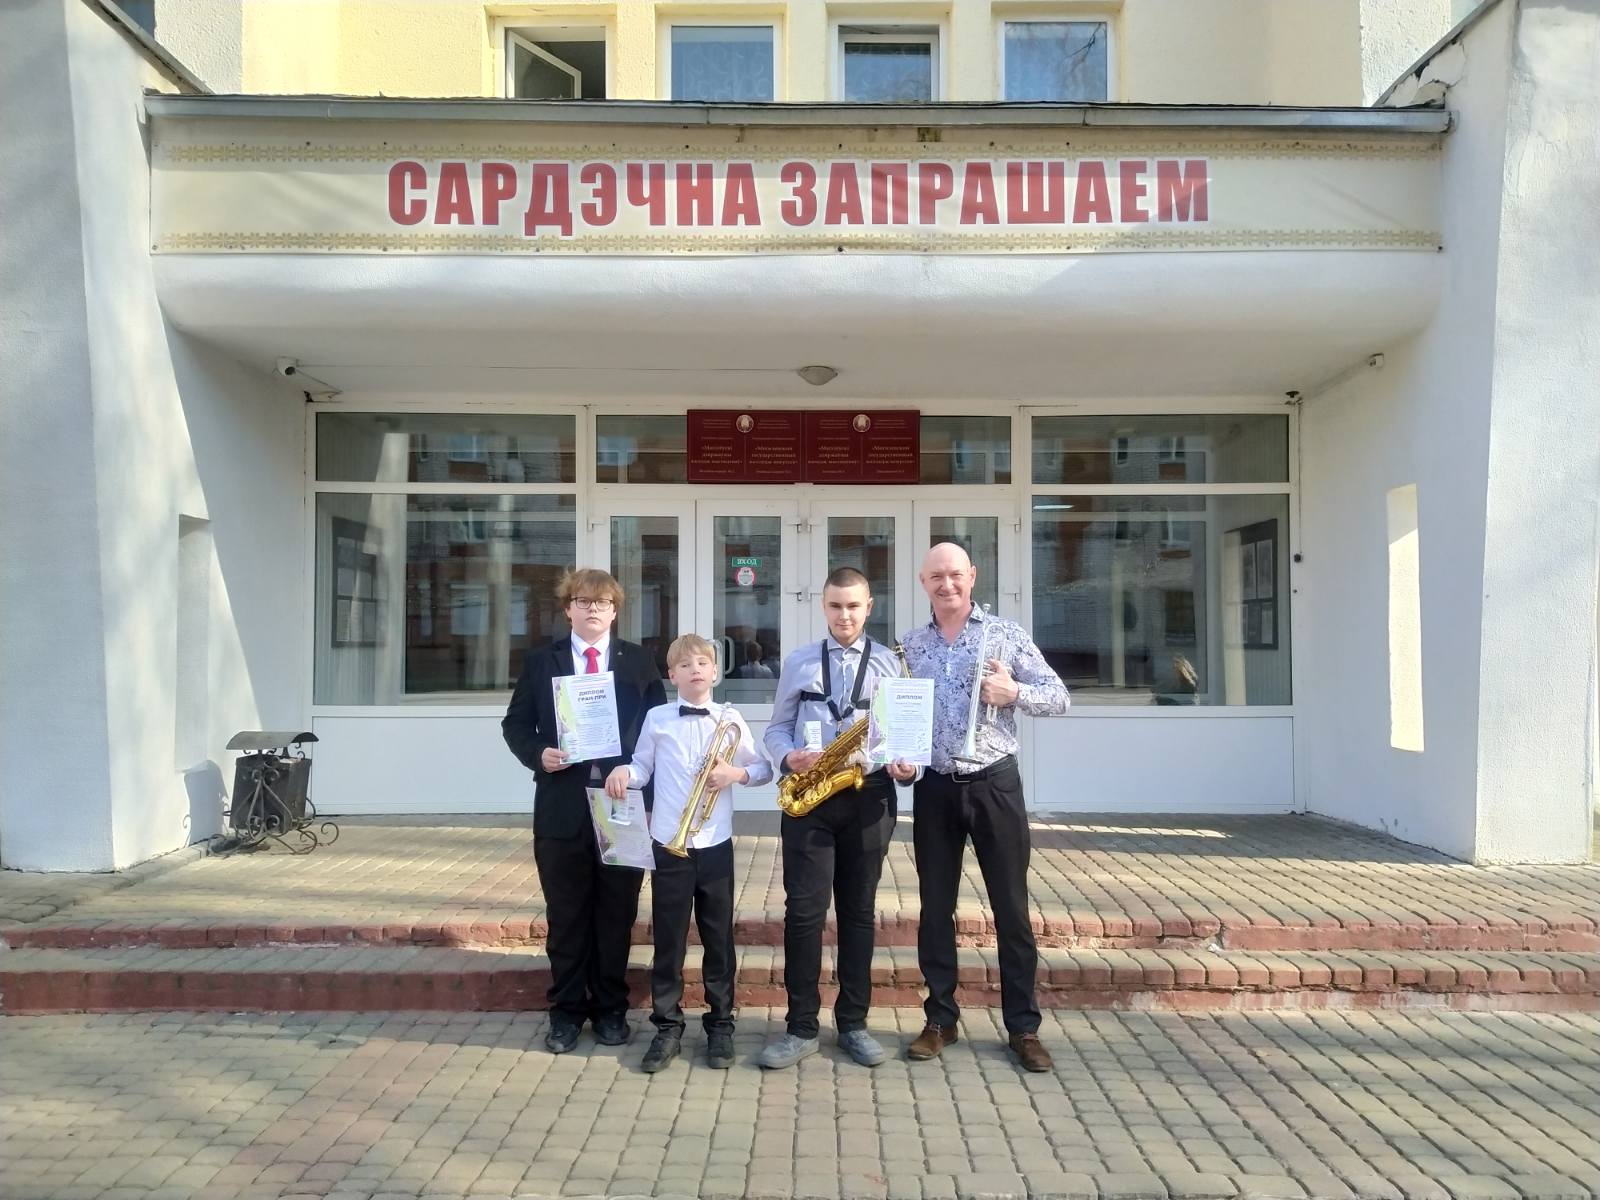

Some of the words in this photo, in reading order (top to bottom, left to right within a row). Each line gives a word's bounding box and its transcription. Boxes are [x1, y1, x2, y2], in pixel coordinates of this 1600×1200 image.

[389, 161, 762, 236] САРДЭЧНА
[781, 159, 1208, 225] ЗАПРАШАЕМ
[736, 558, 757, 567] ВХОД
[578, 689, 605, 697] ДИПЛОМ
